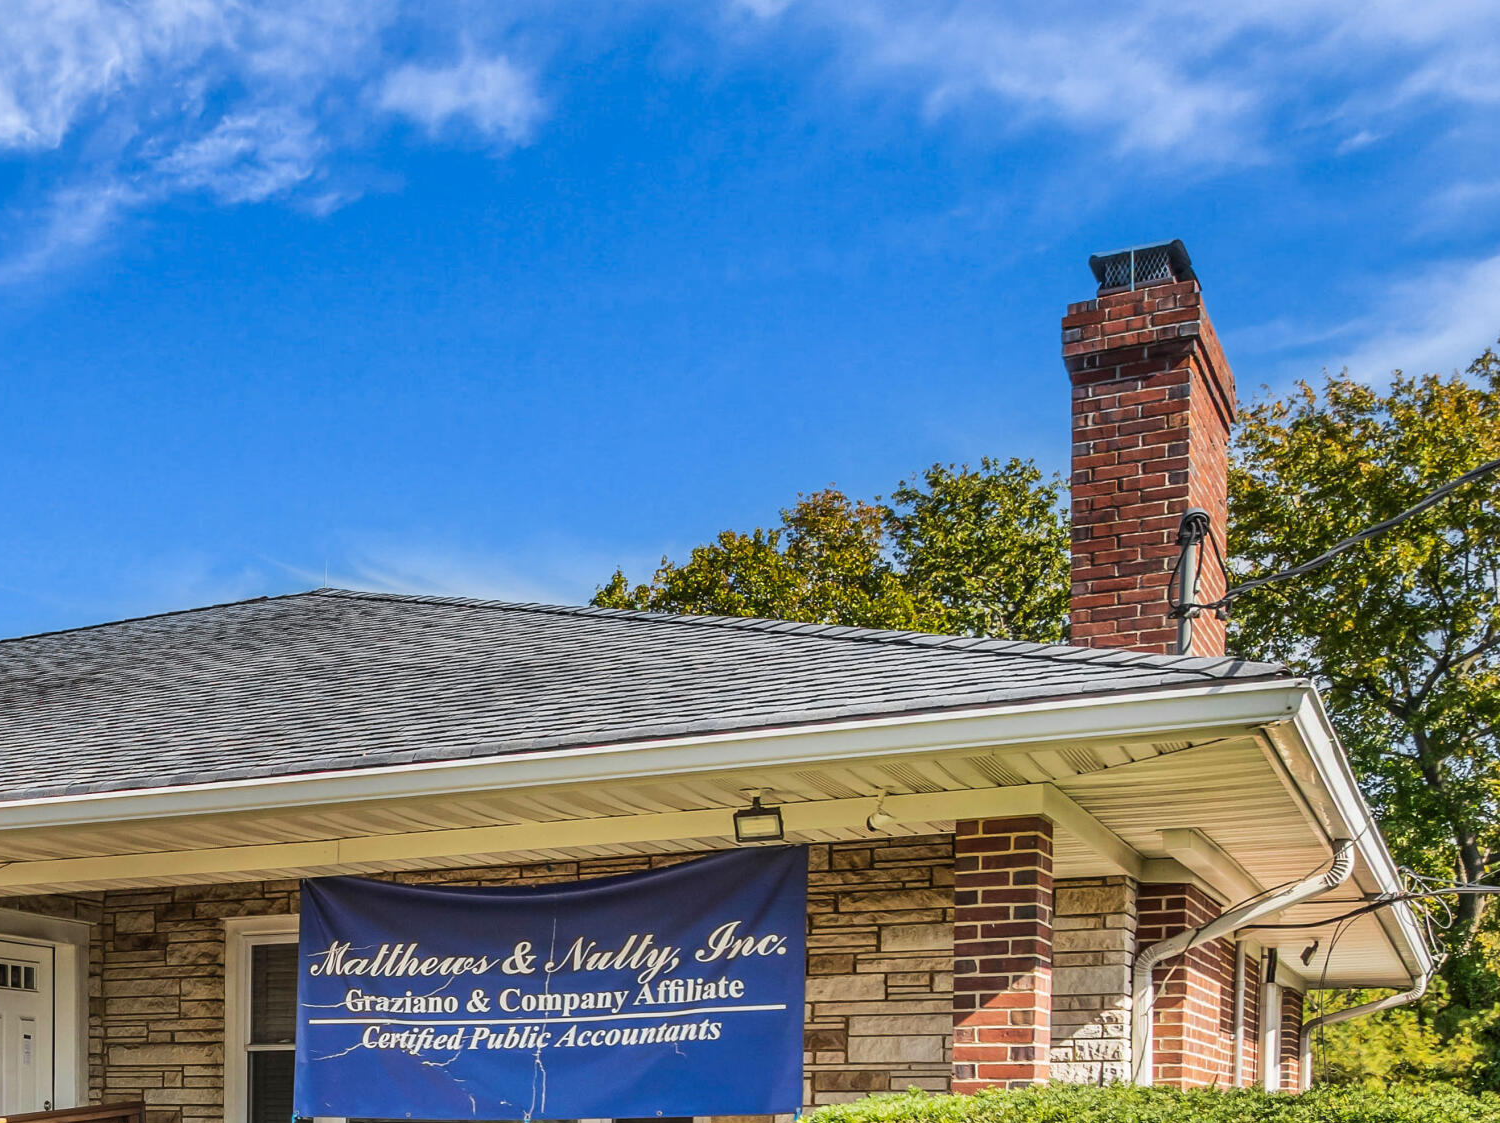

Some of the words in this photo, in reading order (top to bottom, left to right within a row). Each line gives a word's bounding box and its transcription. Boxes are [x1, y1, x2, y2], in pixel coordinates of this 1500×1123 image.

[310, 940, 501, 977] Matthews
[502, 941, 537, 975] &
[694, 920, 788, 962] Inc.
[345, 988, 459, 1014] Graziano
[466, 988, 491, 1013] &
[499, 988, 630, 1018] Company
[632, 975, 745, 1006] Affiliate
[362, 1025, 466, 1055] Certified
[467, 1025, 552, 1050] Public
[553, 1017, 723, 1048] Accountants
